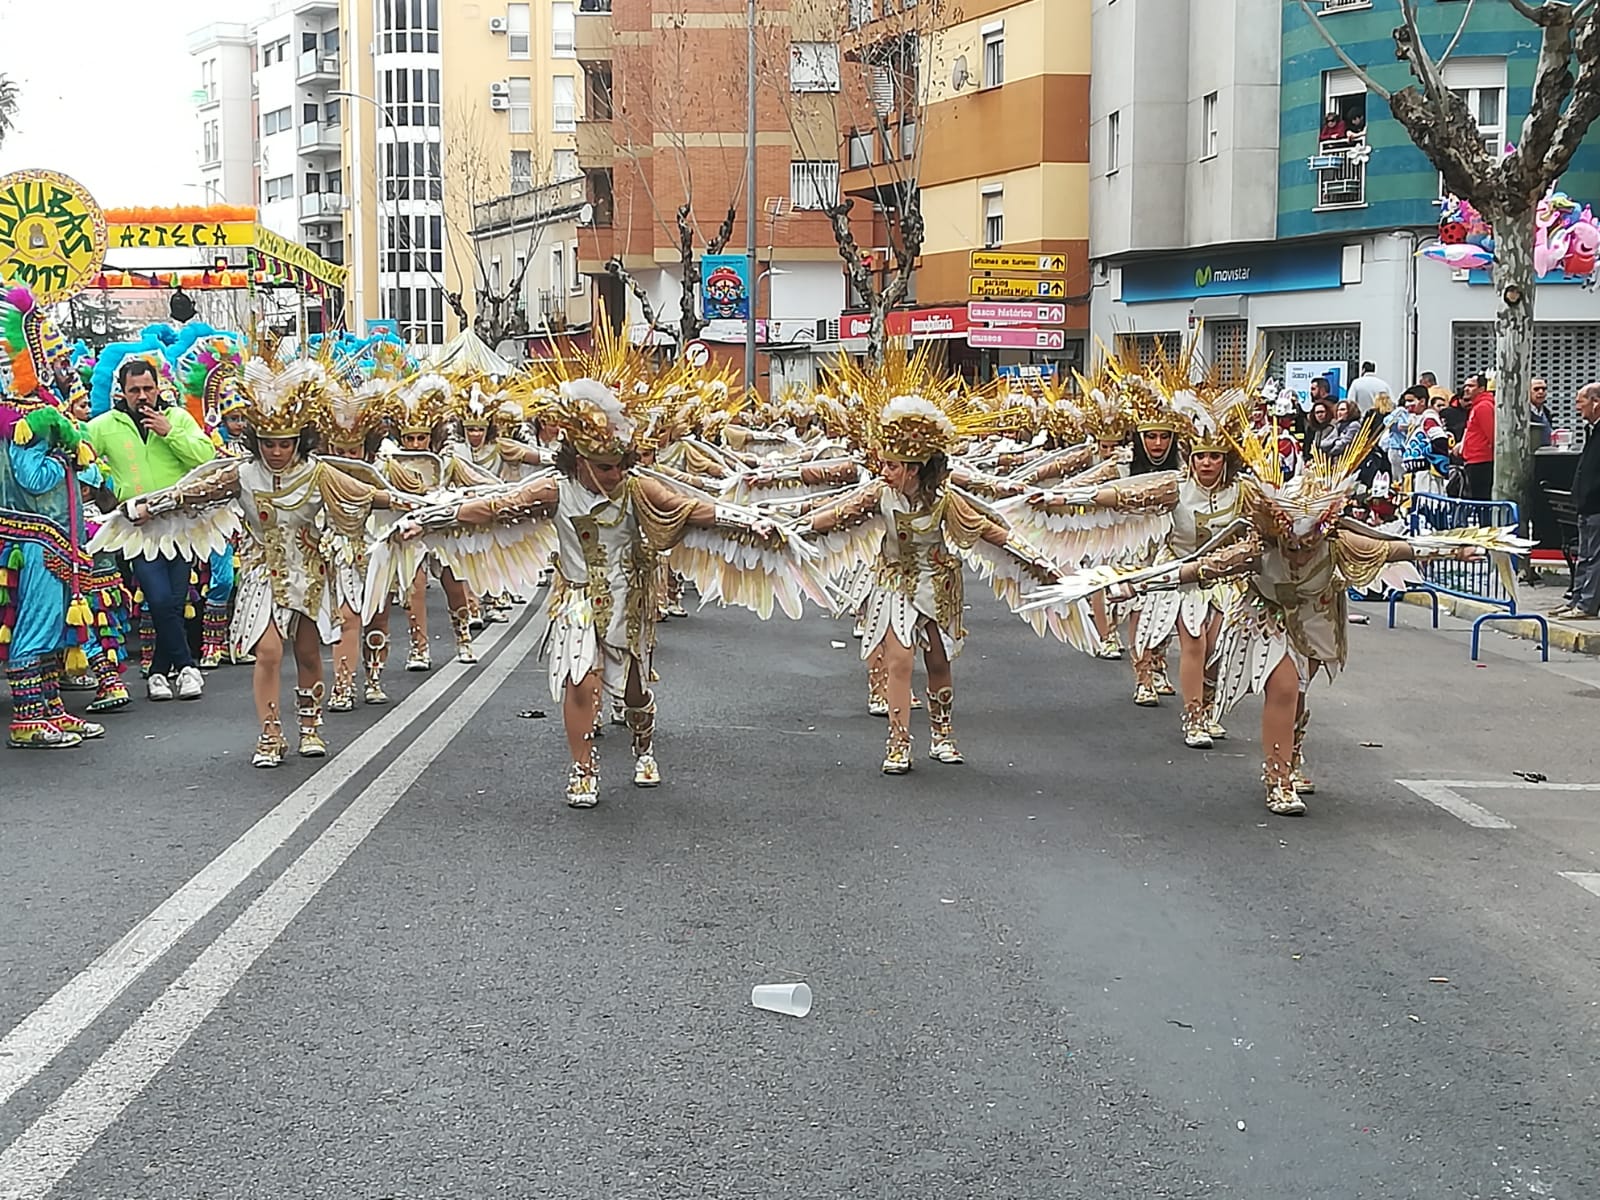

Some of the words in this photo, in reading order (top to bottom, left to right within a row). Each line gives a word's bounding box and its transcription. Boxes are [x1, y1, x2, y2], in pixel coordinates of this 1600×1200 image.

[120, 224, 227, 247] AZTECA
[1012, 258, 1036, 266] turismo
[8, 258, 68, 292] 2019
[1213, 267, 1251, 282] movistar
[984, 279, 1009, 288] parking
[977, 286, 994, 296] Plaza
[994, 286, 1014, 297] Santa
[971, 334, 1002, 343] museos
